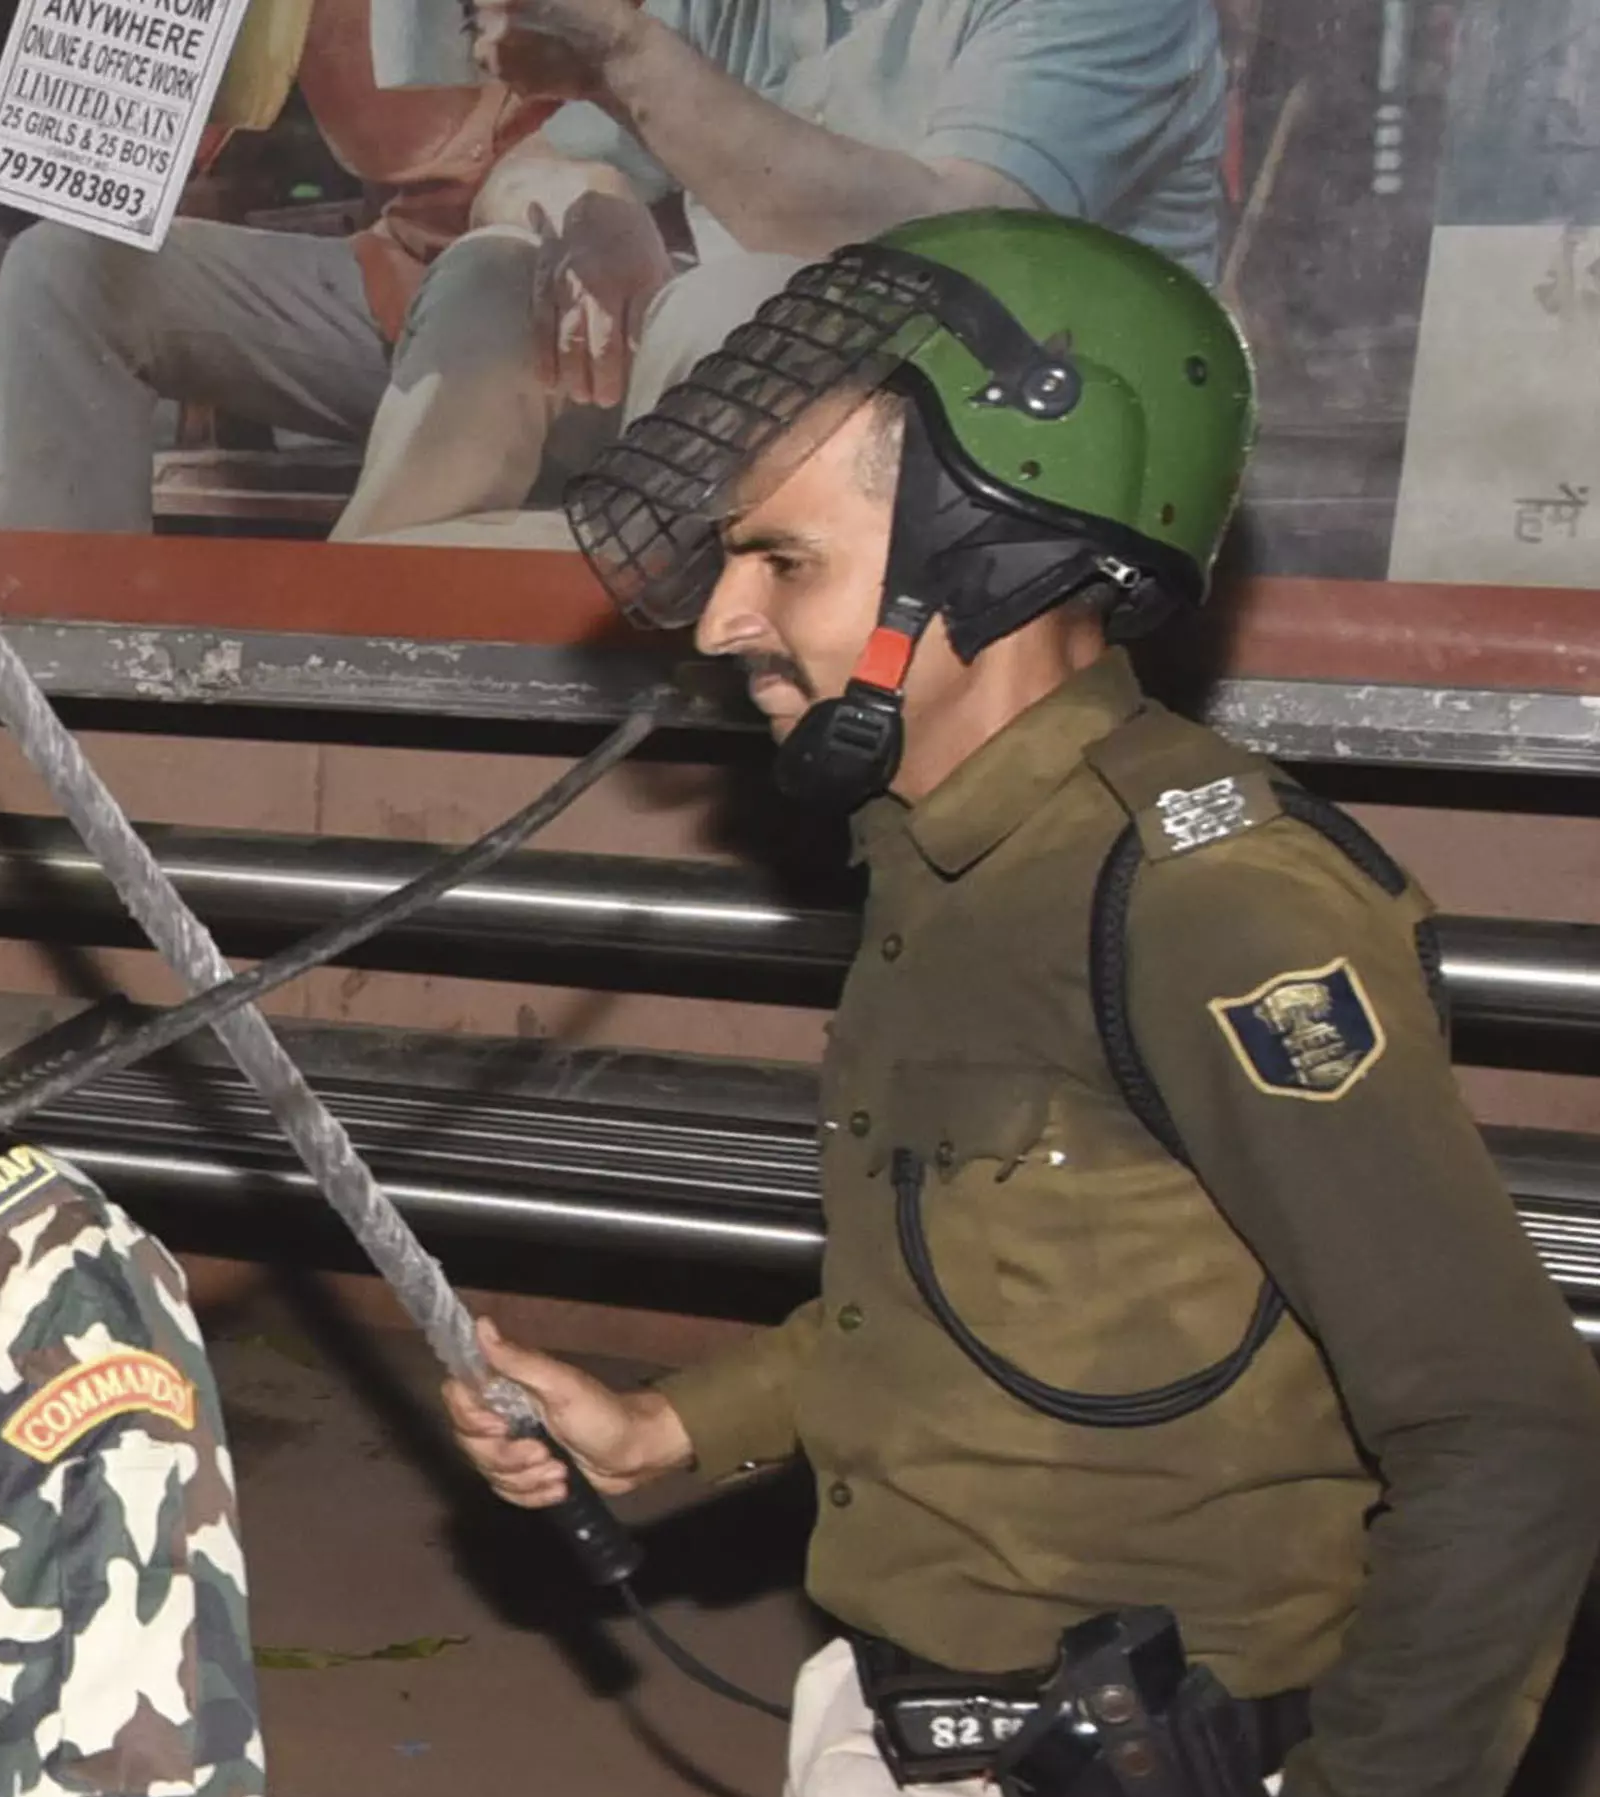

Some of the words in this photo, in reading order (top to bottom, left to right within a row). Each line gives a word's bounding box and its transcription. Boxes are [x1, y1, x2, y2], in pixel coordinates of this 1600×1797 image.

[22, 24, 81, 67] ONLINE
[79, 41, 94, 70] &
[94, 45, 150, 87] OFFICE
[150, 61, 200, 101] WORK
[43, 0, 204, 60] ANYWHERE
[1, 104, 21, 131] 25
[25, 111, 77, 148] GIRLS
[79, 128, 92, 152] &
[95, 132, 117, 159] 25
[121, 140, 171, 176] BOYS
[16, 68, 109, 121] LIMITED
[108, 93, 179, 143] SEATS
[22, 1362, 187, 1450] COMMANDO
[930, 1716, 983, 1748] 82
